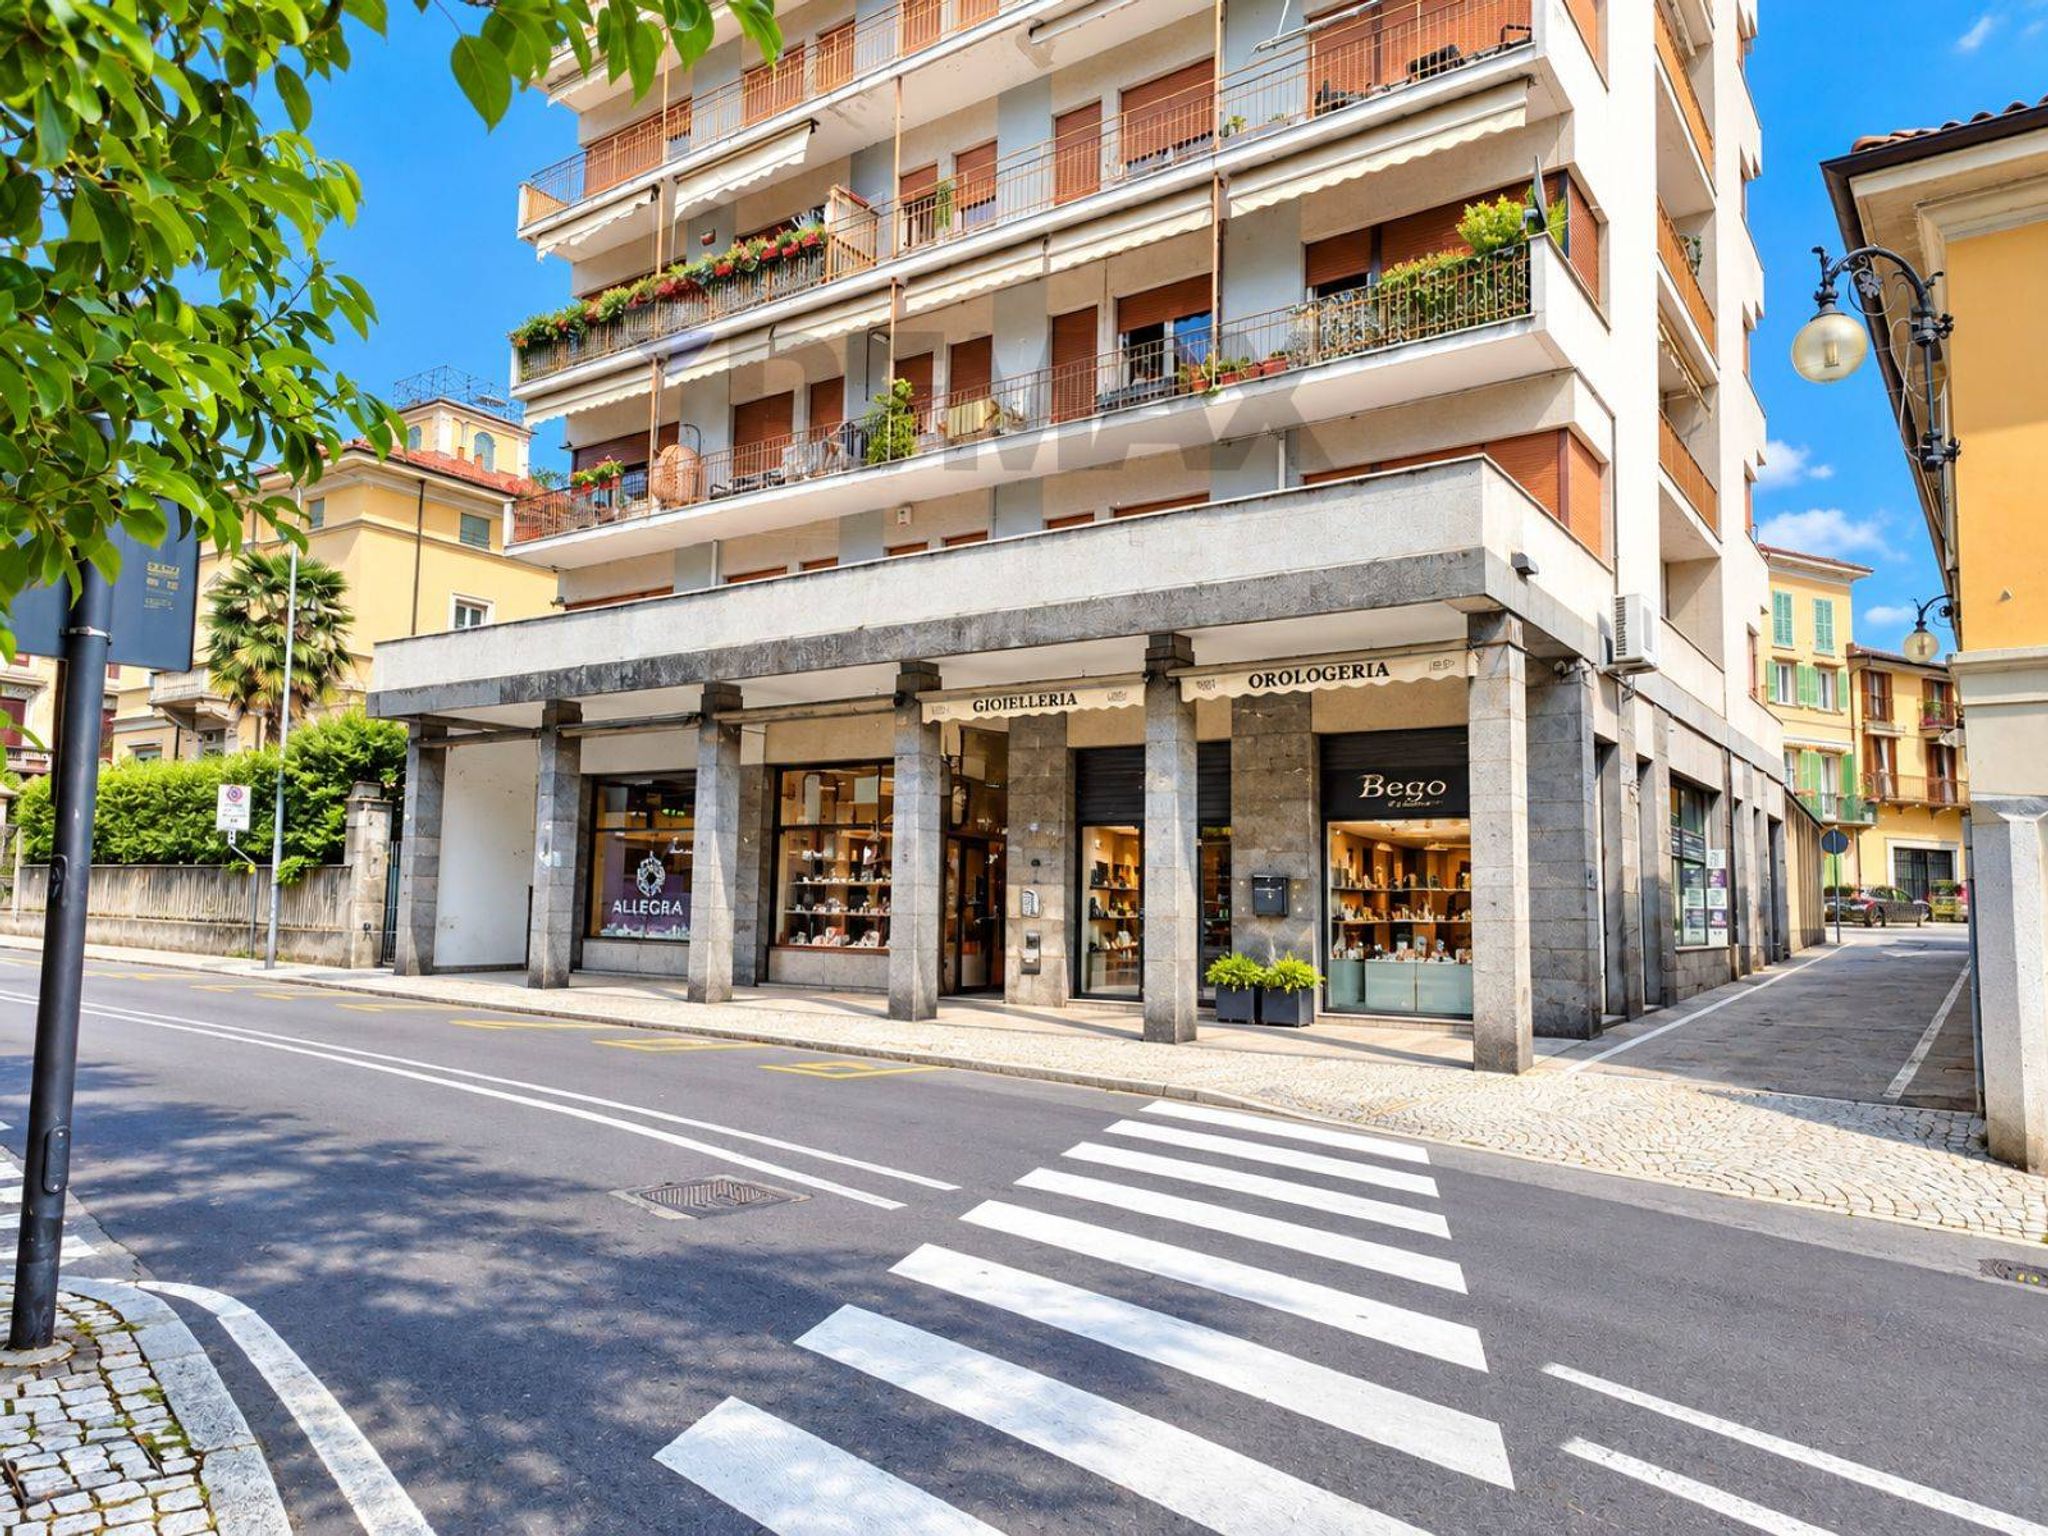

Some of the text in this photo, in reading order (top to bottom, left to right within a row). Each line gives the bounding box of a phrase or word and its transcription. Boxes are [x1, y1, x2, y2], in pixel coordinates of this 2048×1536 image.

[1249, 661, 1390, 690] OROLOGERIA
[973, 691, 1078, 713] GIOIELLERIA
[1358, 773, 1447, 802] Bego
[611, 899, 684, 916] ALLEGRA
